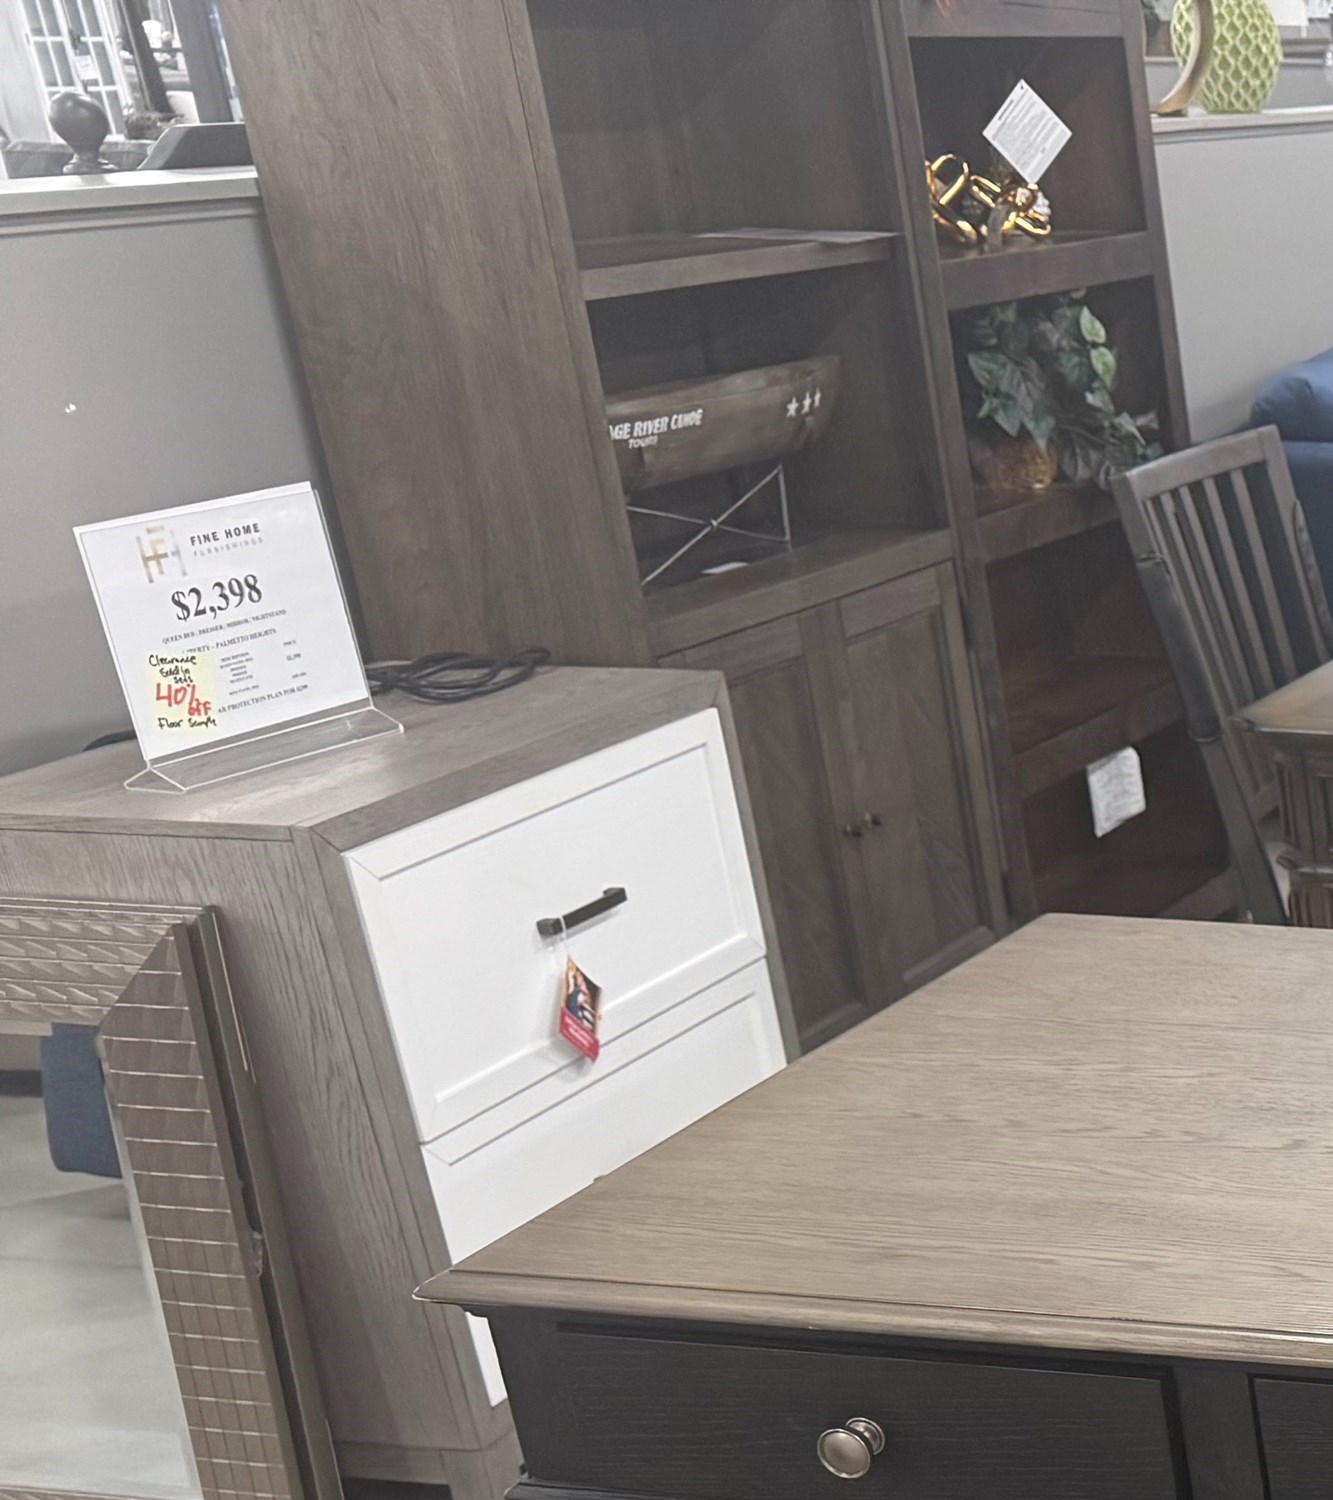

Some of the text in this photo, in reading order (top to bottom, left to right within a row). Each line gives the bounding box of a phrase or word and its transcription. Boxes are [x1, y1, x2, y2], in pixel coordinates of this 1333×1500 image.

[633, 415, 669, 437] RIVER
[670, 408, 703, 431] CANOE
[190, 523, 261, 546] FINE HOME
[193, 536, 264, 557] FURNISHINGS
[171, 574, 262, 622] $2,398
[216, 635, 249, 649] PALMETTO
[156, 682, 196, 708] 40%
[157, 717, 183, 730] Floor
